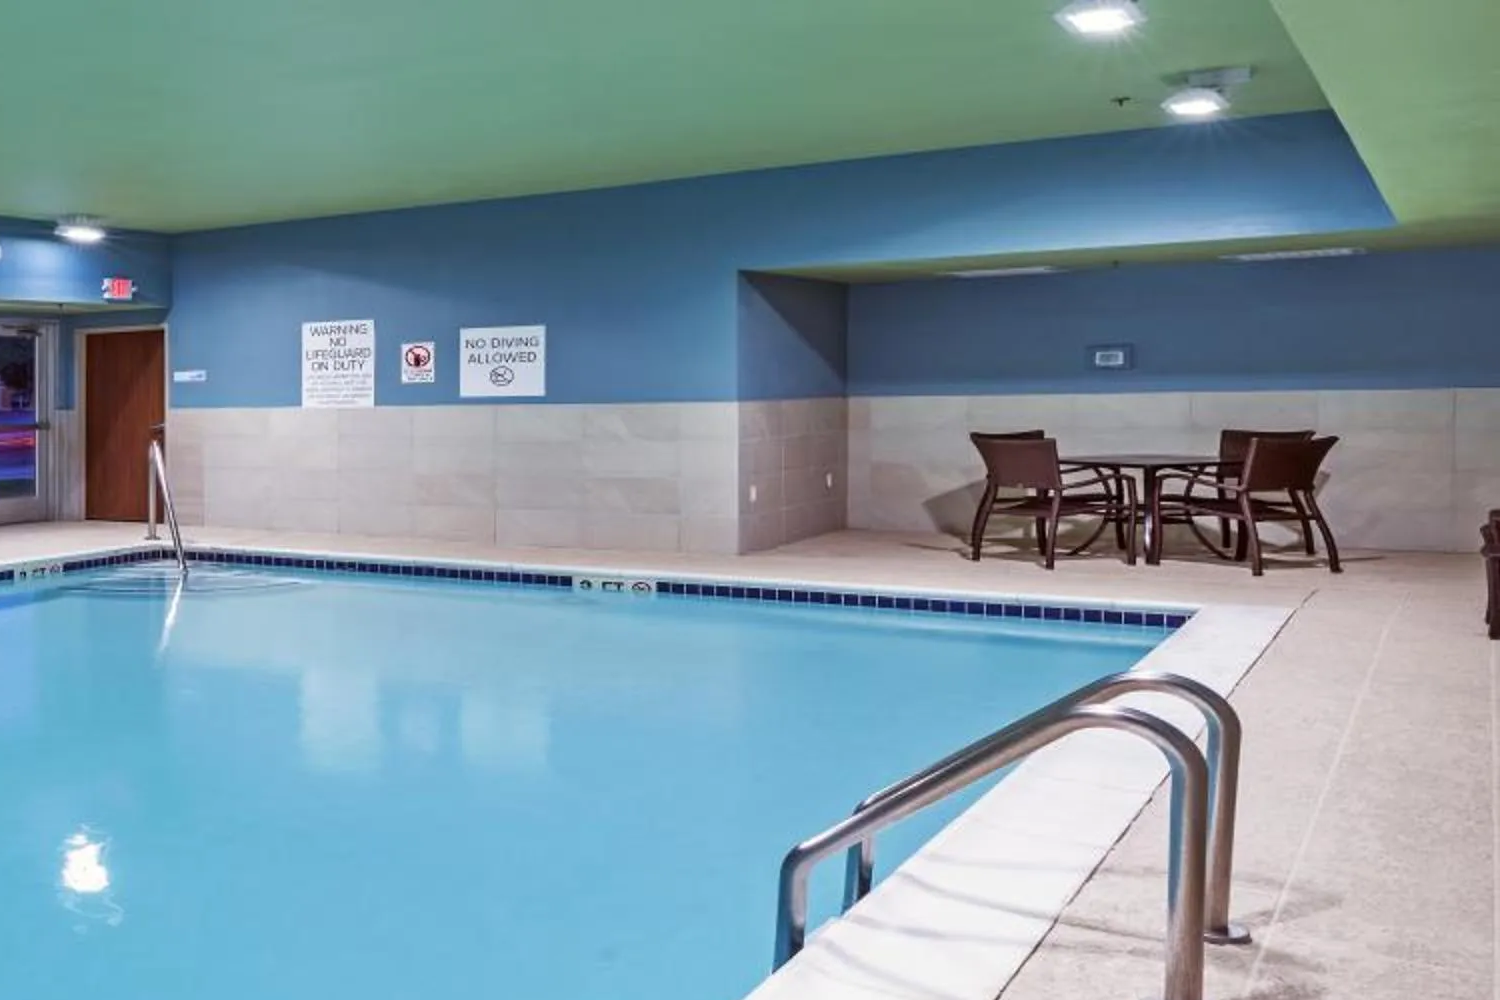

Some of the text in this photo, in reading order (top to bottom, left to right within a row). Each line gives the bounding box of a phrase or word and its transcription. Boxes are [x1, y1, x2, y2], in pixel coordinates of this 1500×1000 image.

[309, 324, 368, 337] WARNING
[329, 337, 347, 347] NO
[465, 336, 540, 349] NO DIVING
[305, 347, 372, 361] LIFEGUARD
[468, 351, 537, 364] ALLOWED
[311, 359, 366, 371] ON DUTY
